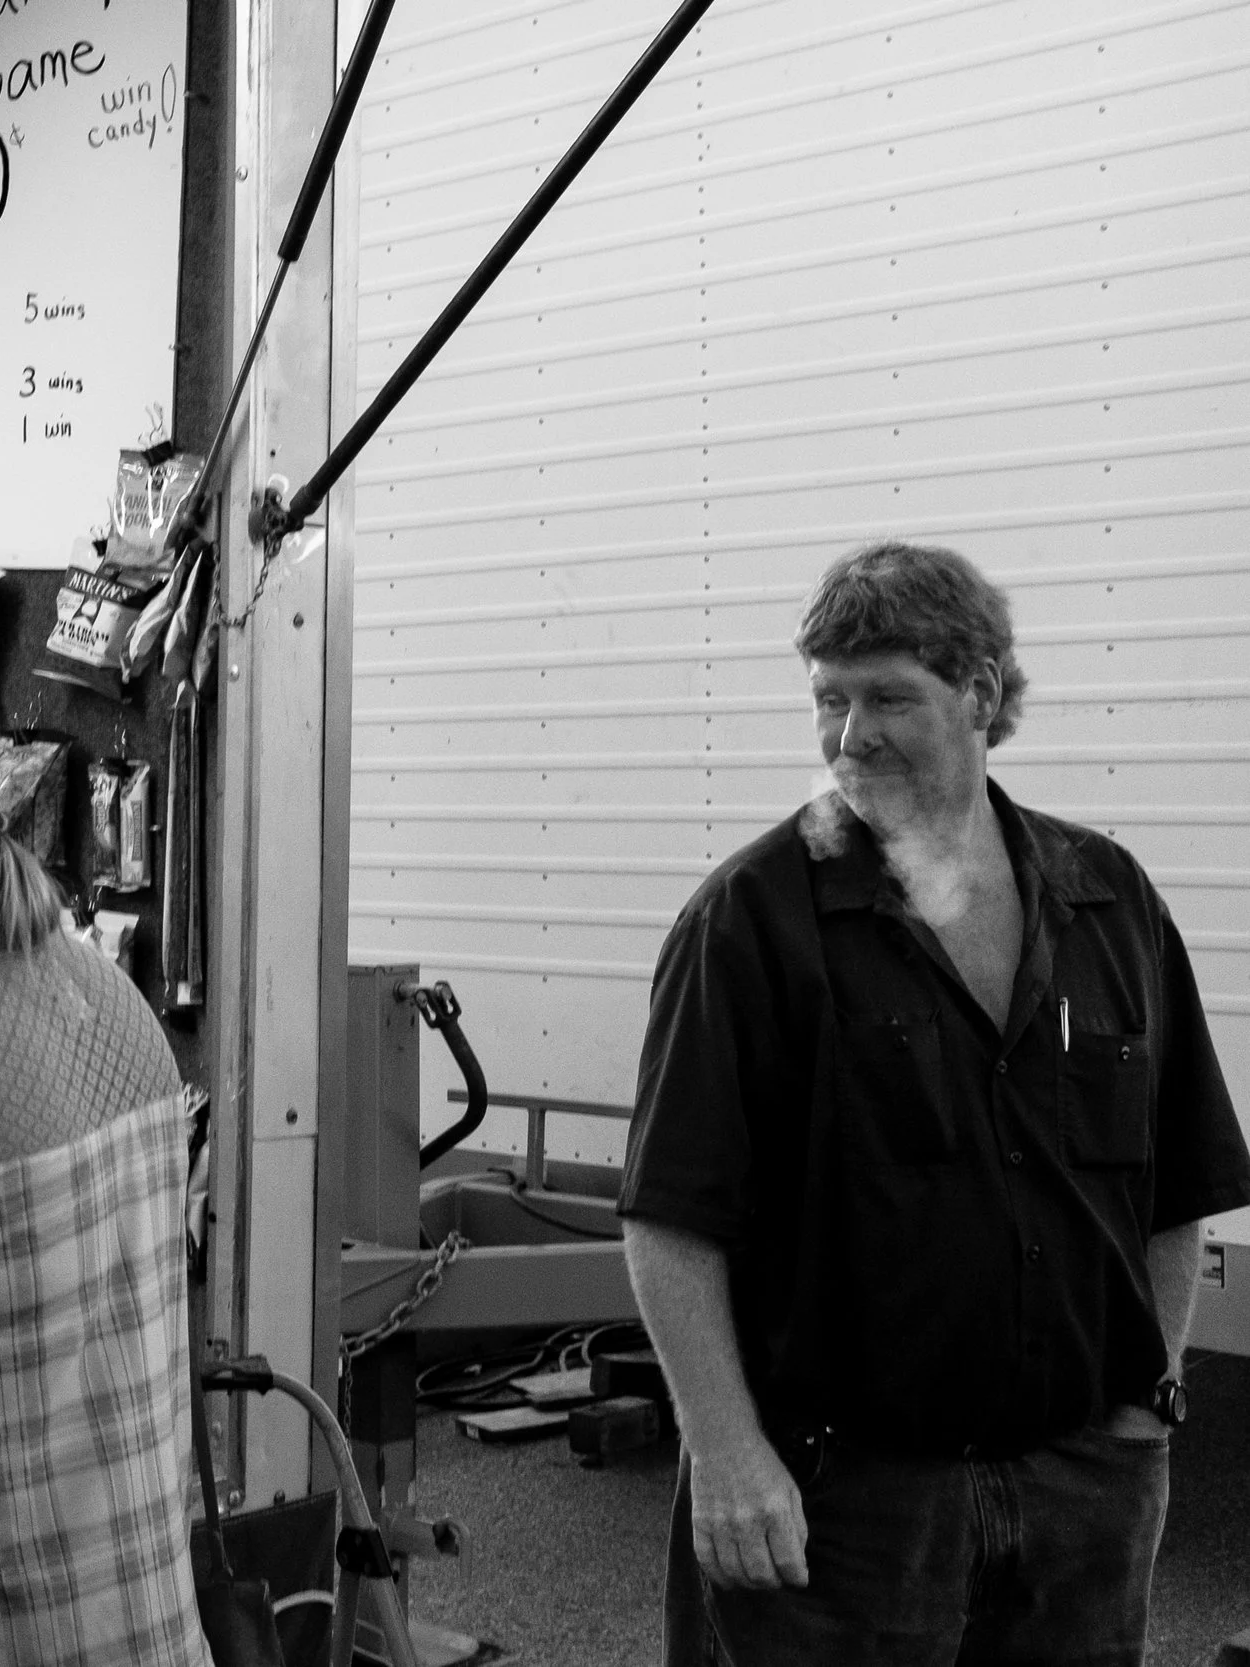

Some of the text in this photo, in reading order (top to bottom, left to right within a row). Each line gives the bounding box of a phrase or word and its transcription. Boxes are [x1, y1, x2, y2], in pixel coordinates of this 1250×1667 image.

[100, 74, 151, 114] win
[24, 292, 86, 324] 5 wins
[19, 366, 85, 399] 3 wins
[44, 420, 73, 440] win
